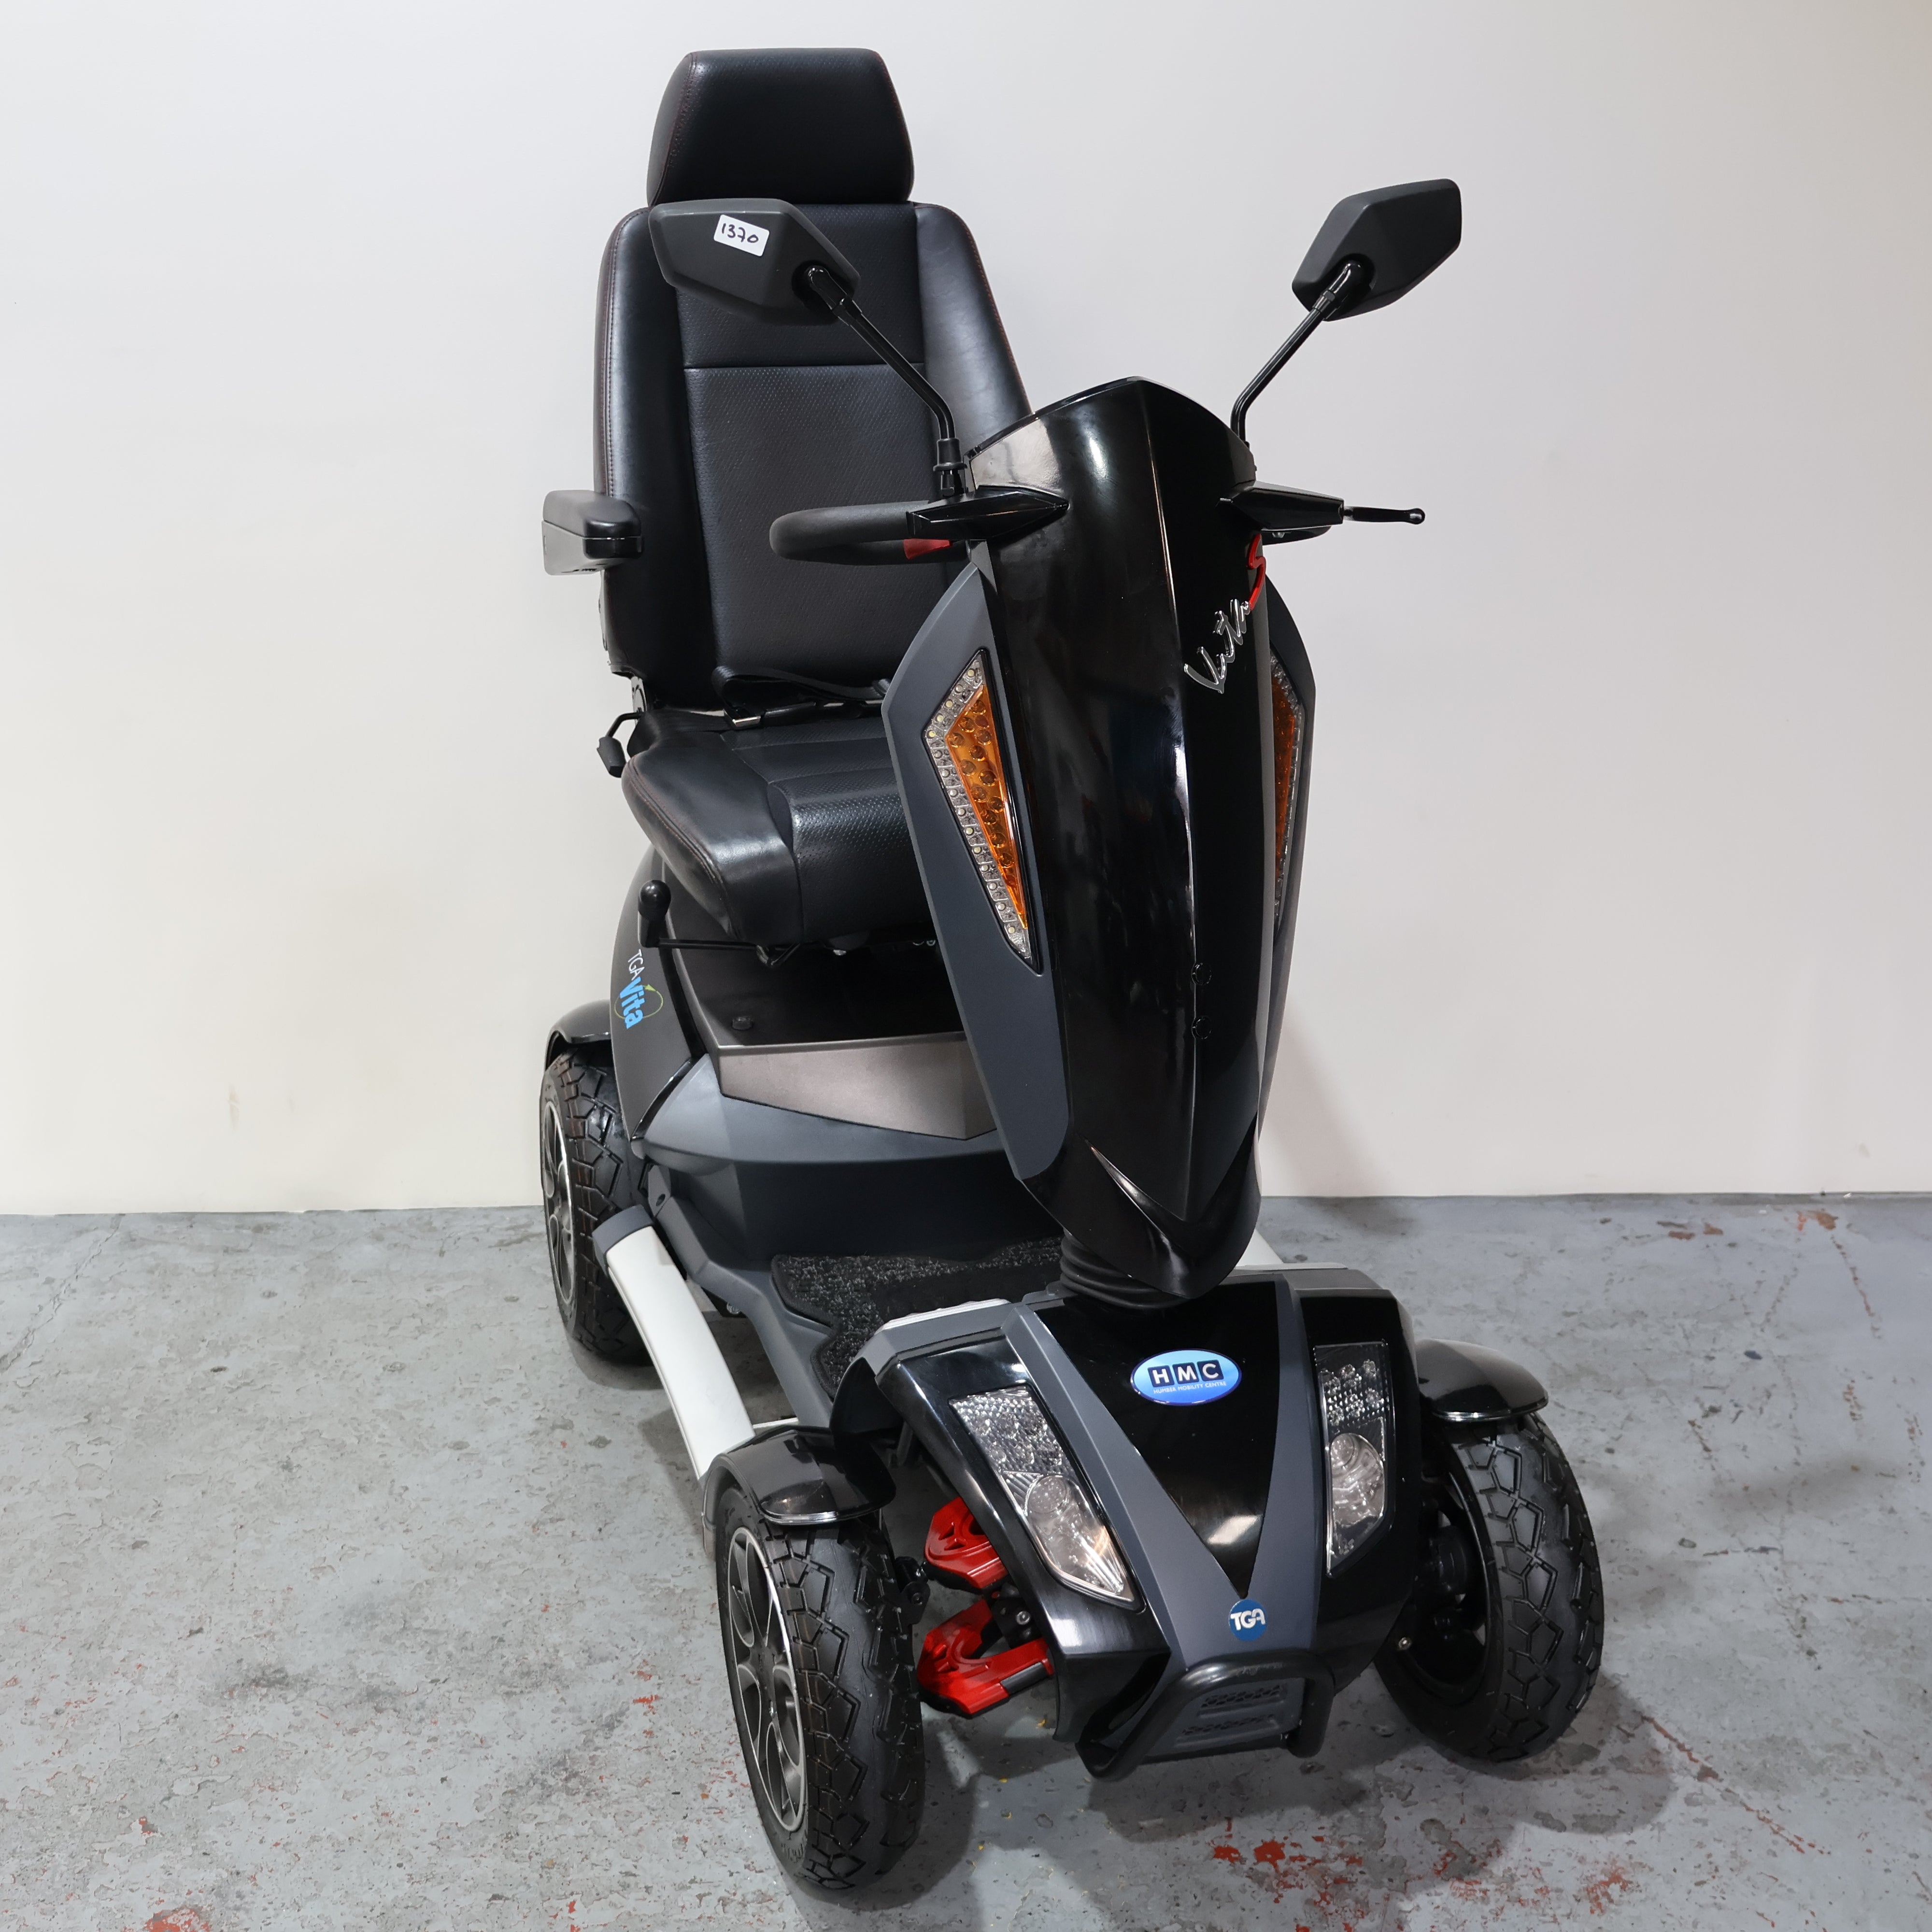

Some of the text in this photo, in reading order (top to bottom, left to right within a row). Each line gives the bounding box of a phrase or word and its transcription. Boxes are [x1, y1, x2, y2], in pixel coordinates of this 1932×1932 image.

[722, 223, 759, 243] 1370
[619, 949, 645, 1029] TGA Vita
[1151, 1363, 1220, 1385] HMC
[1230, 1608, 1266, 1631] TGA
